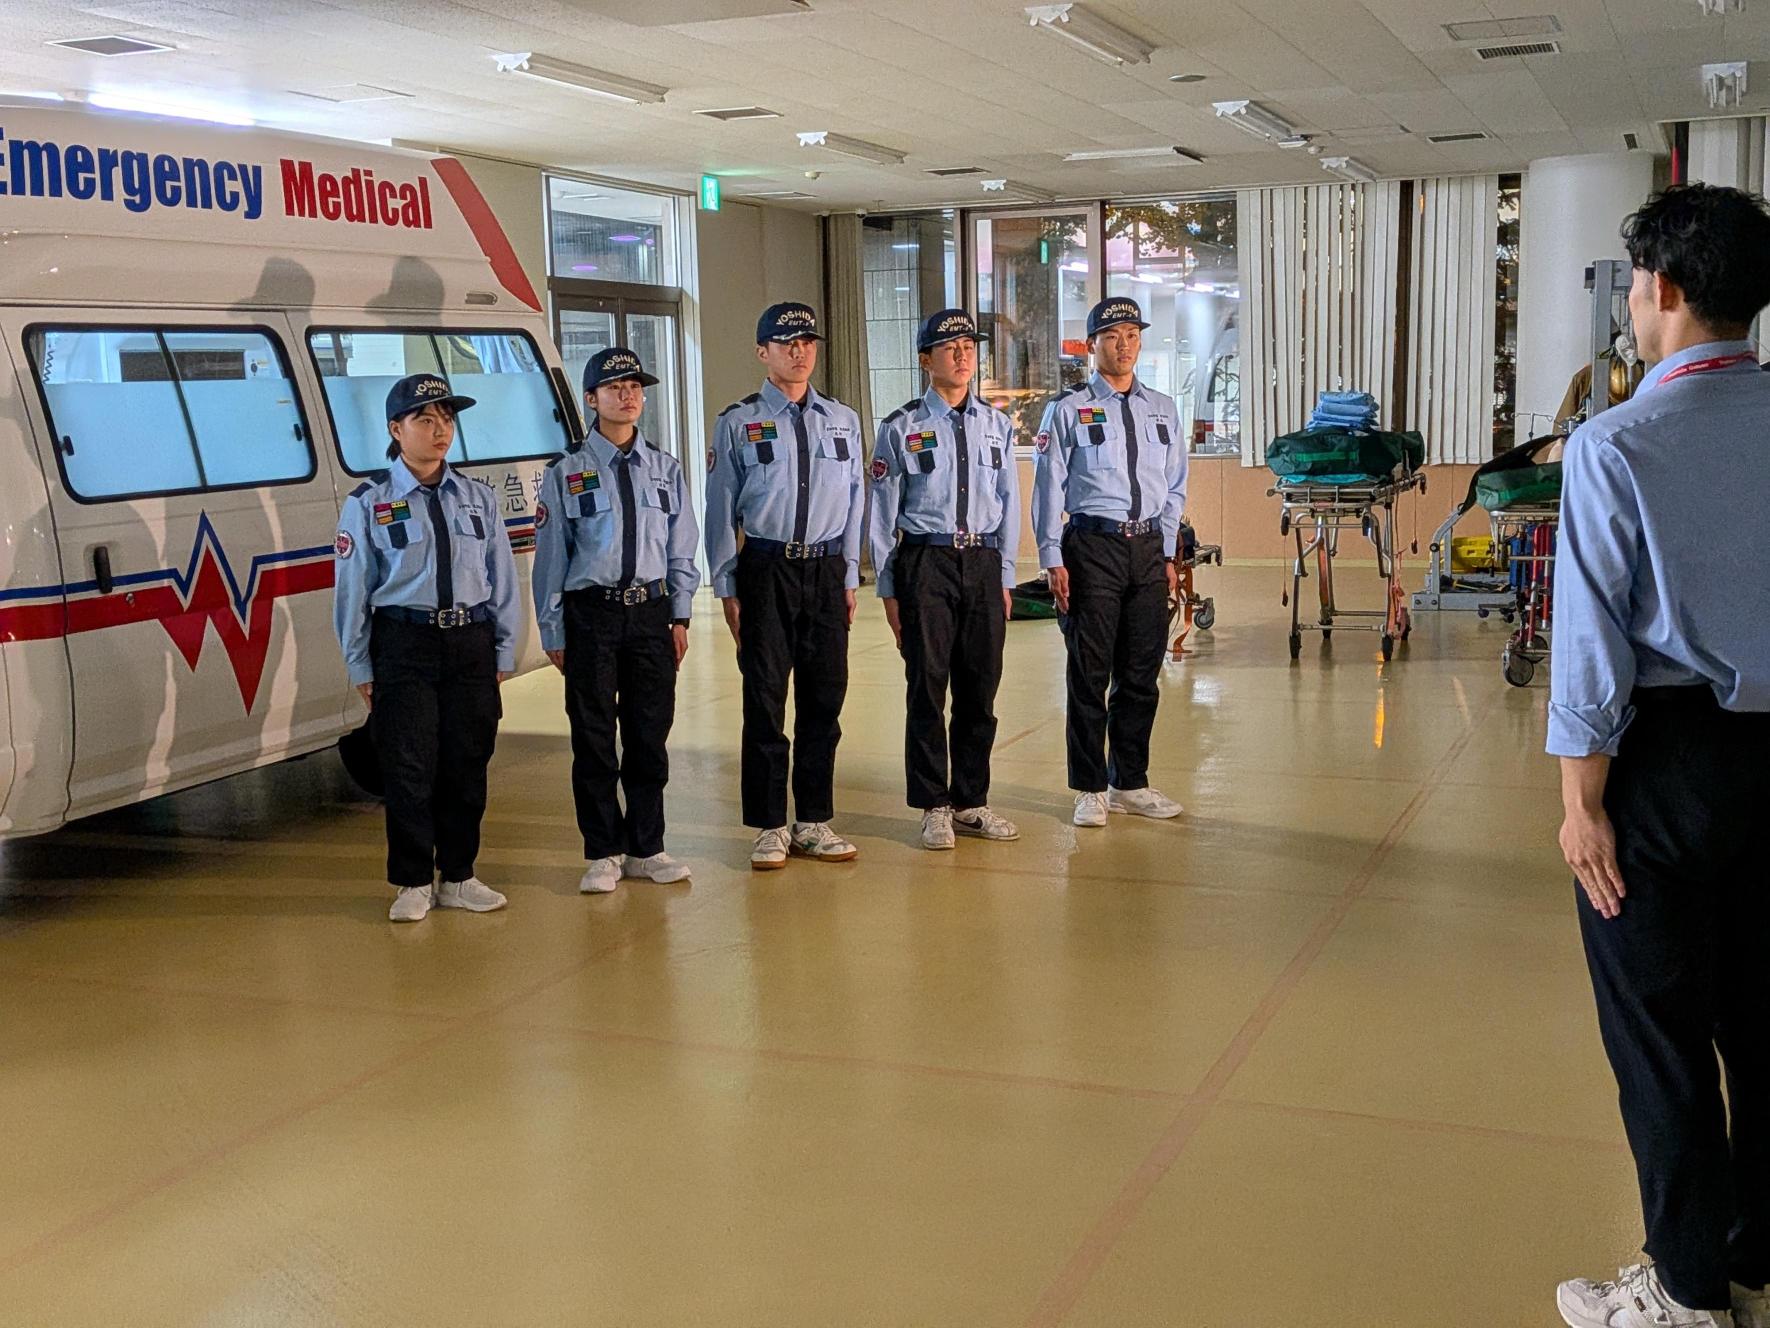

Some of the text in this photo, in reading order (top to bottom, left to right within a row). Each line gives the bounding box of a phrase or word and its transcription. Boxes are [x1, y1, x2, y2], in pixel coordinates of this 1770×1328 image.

[0, 127, 432, 229] mergency Medical
[776, 310, 815, 327] YOSHIDA
[1101, 303, 1139, 319] YOSHIDA
[937, 316, 973, 332] YOSHIDA
[414, 379, 449, 396] YOSHID
